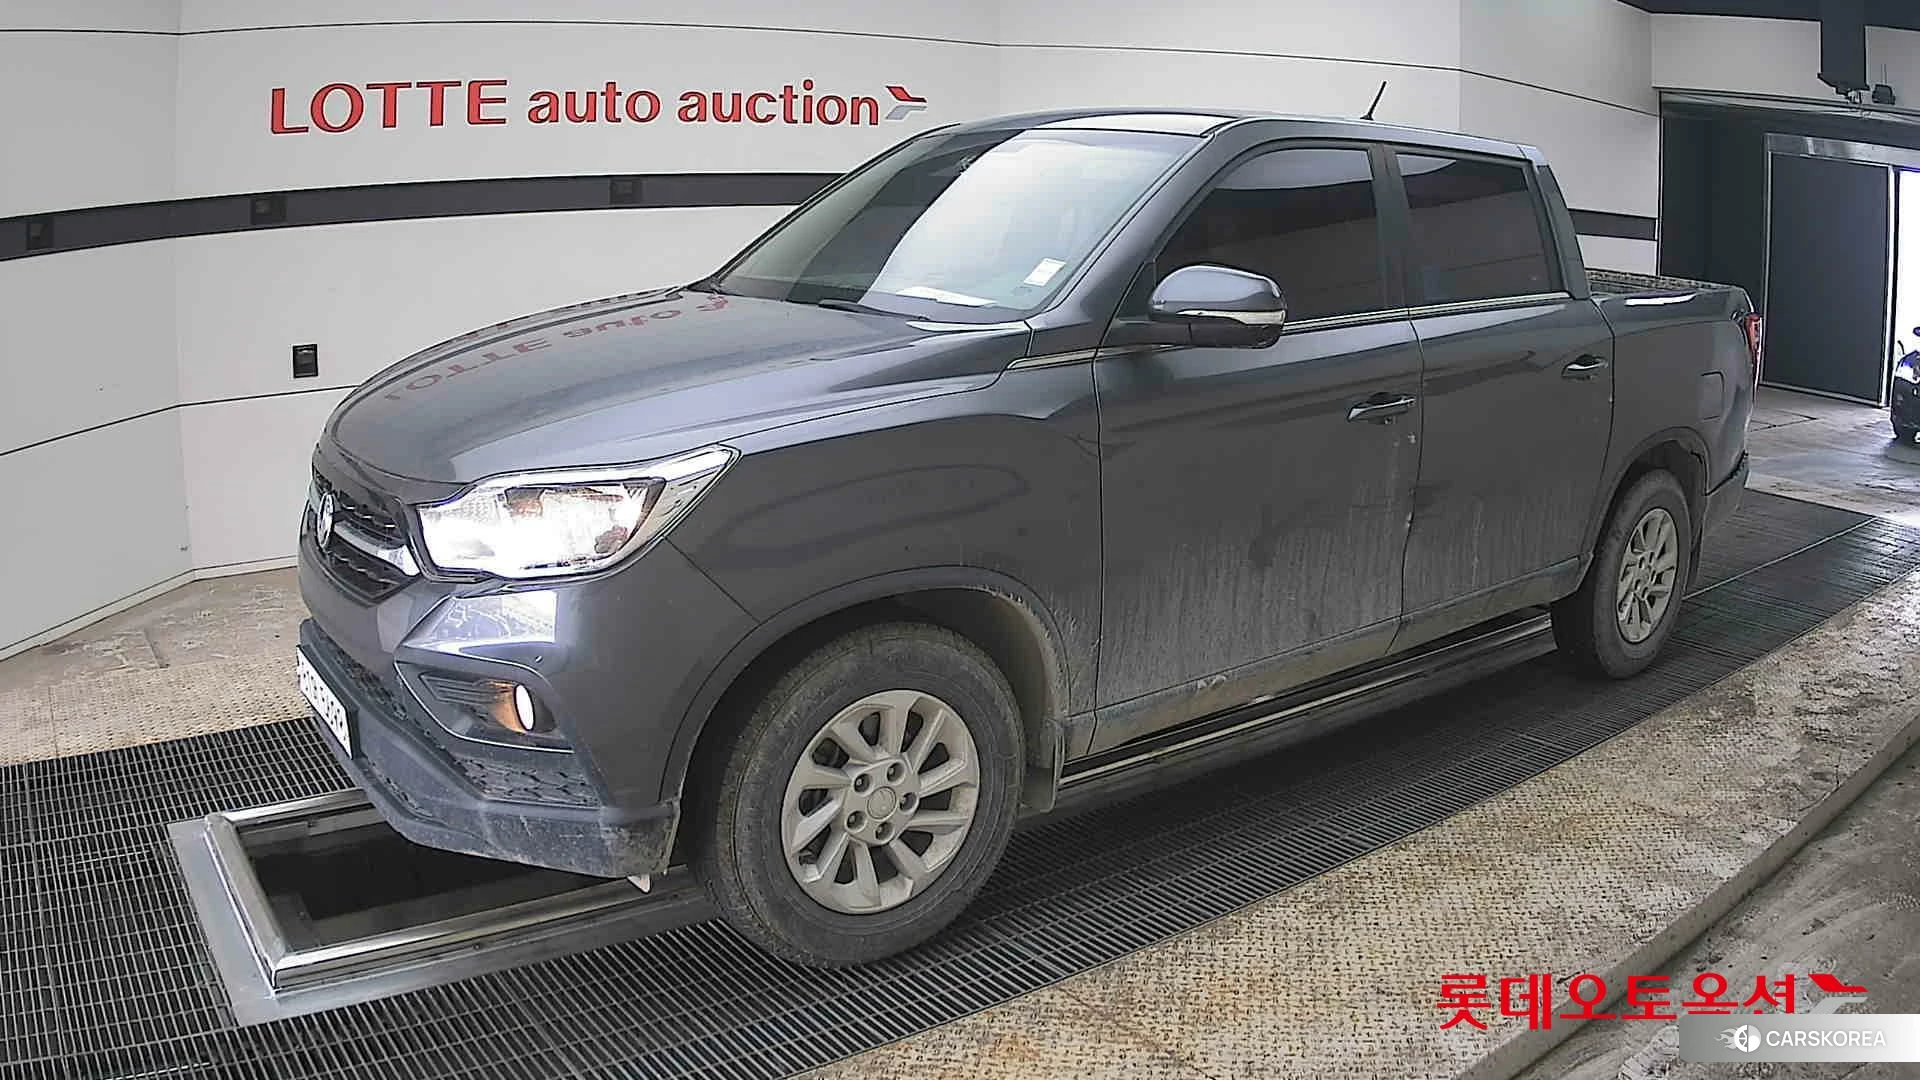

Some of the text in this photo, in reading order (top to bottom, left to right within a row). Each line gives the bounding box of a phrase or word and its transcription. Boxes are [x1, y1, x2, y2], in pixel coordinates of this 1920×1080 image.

[270, 79, 880, 135] LOTTE auto auction
